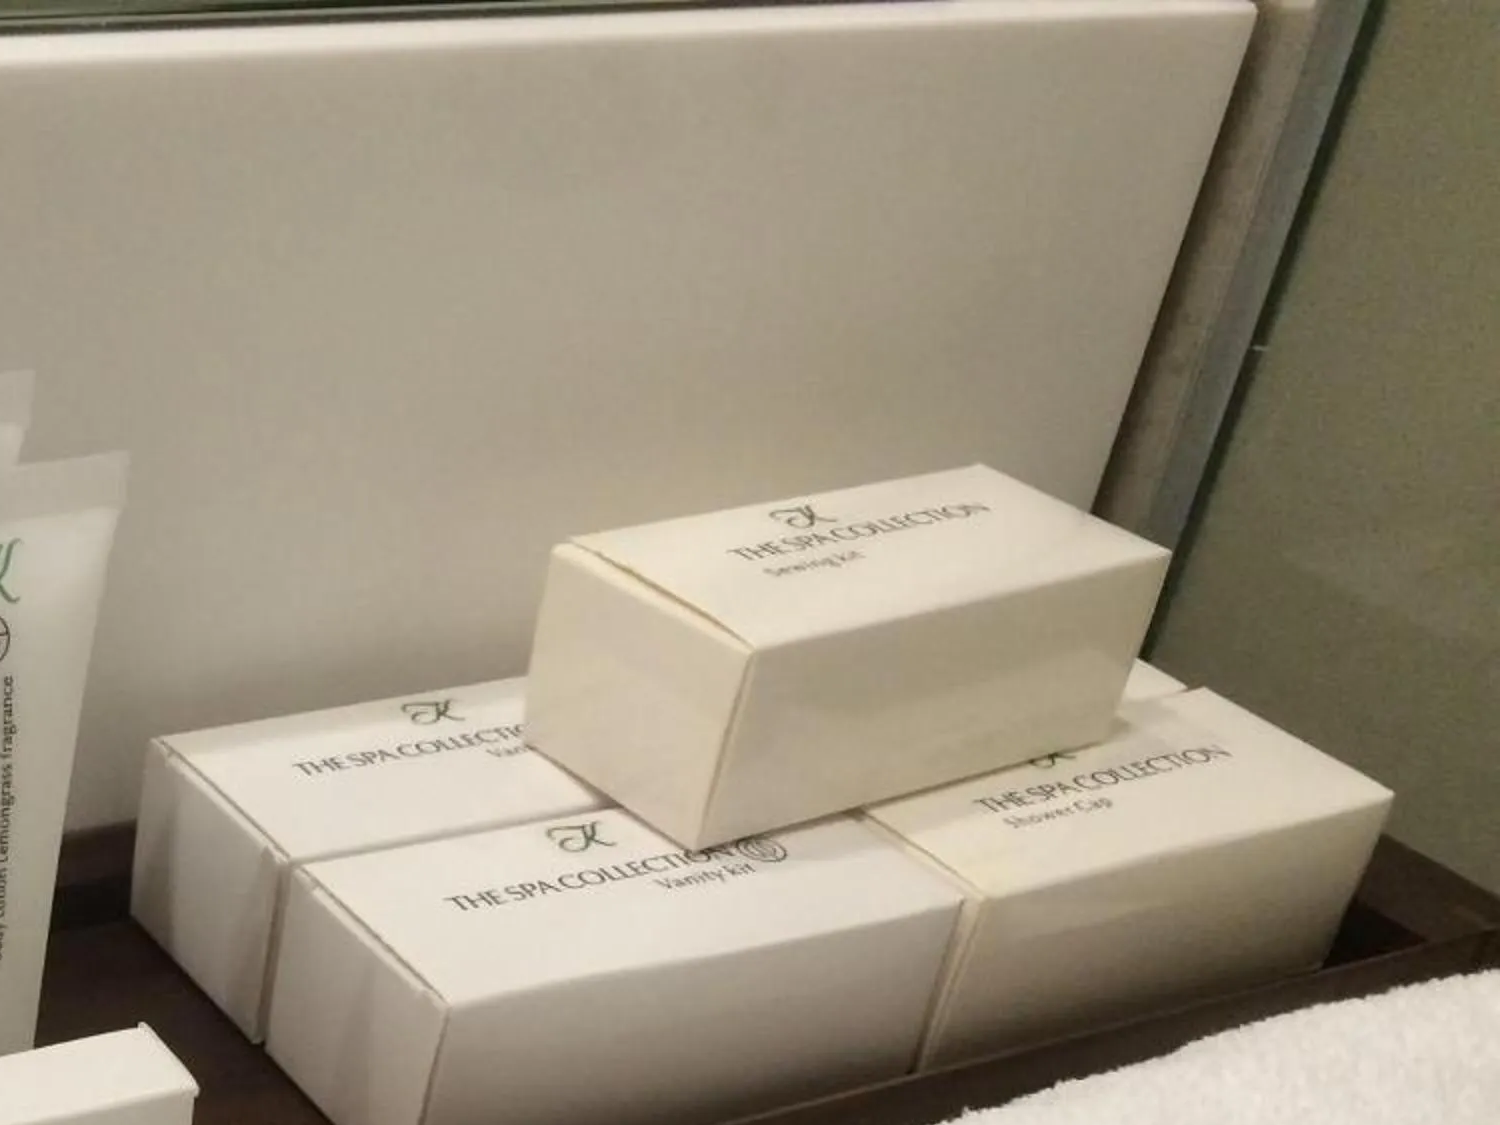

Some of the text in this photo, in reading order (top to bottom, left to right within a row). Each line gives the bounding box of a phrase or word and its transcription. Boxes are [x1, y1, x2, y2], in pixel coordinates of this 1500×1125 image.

[725, 503, 992, 561] THE SPA COLLECTION
[0, 675, 17, 759] fragrance
[293, 757, 350, 777] THE
[348, 749, 401, 768] SPA
[973, 744, 1234, 814] THE SPA COLLECTION
[443, 888, 509, 912] THE
[503, 880, 562, 901] SPA
[653, 869, 726, 890] Vanity
